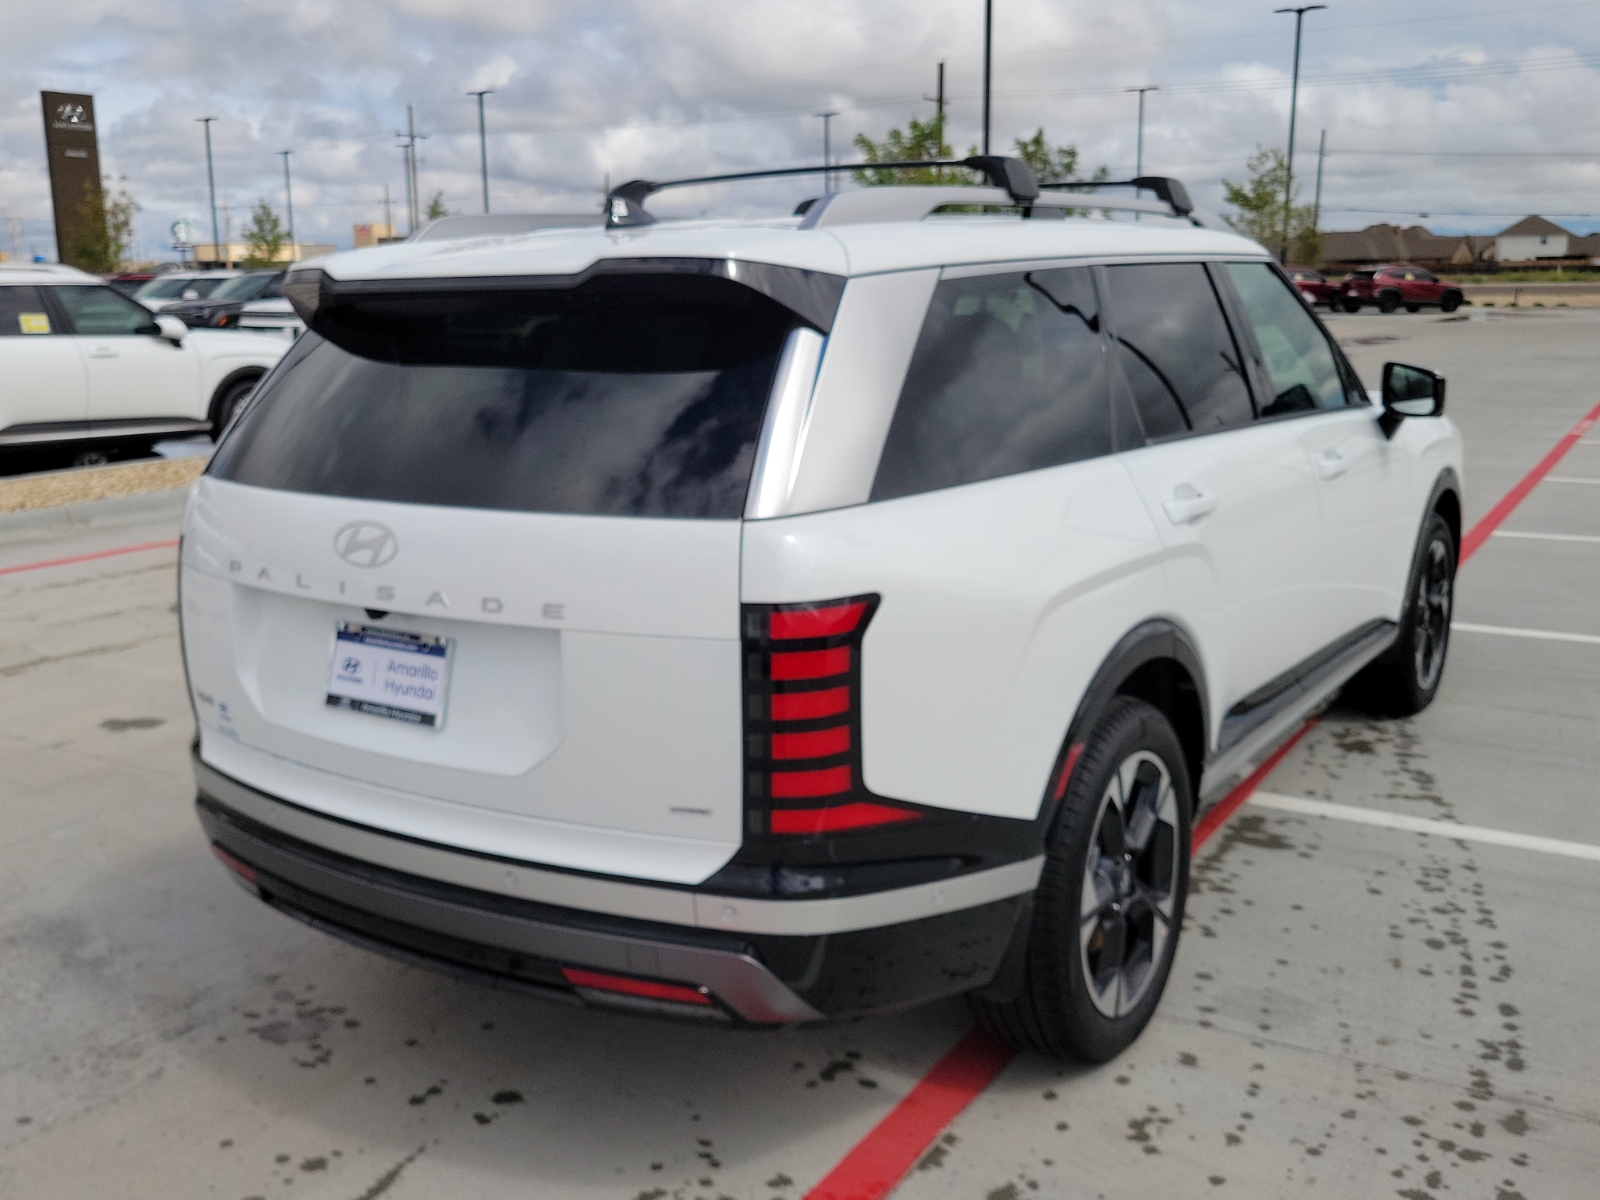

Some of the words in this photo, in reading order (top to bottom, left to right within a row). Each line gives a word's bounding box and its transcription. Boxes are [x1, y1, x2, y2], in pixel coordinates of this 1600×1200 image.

[229, 559, 566, 620] PALISADE
[387, 659, 439, 681] Amarillo
[384, 679, 436, 701] Hyundai
